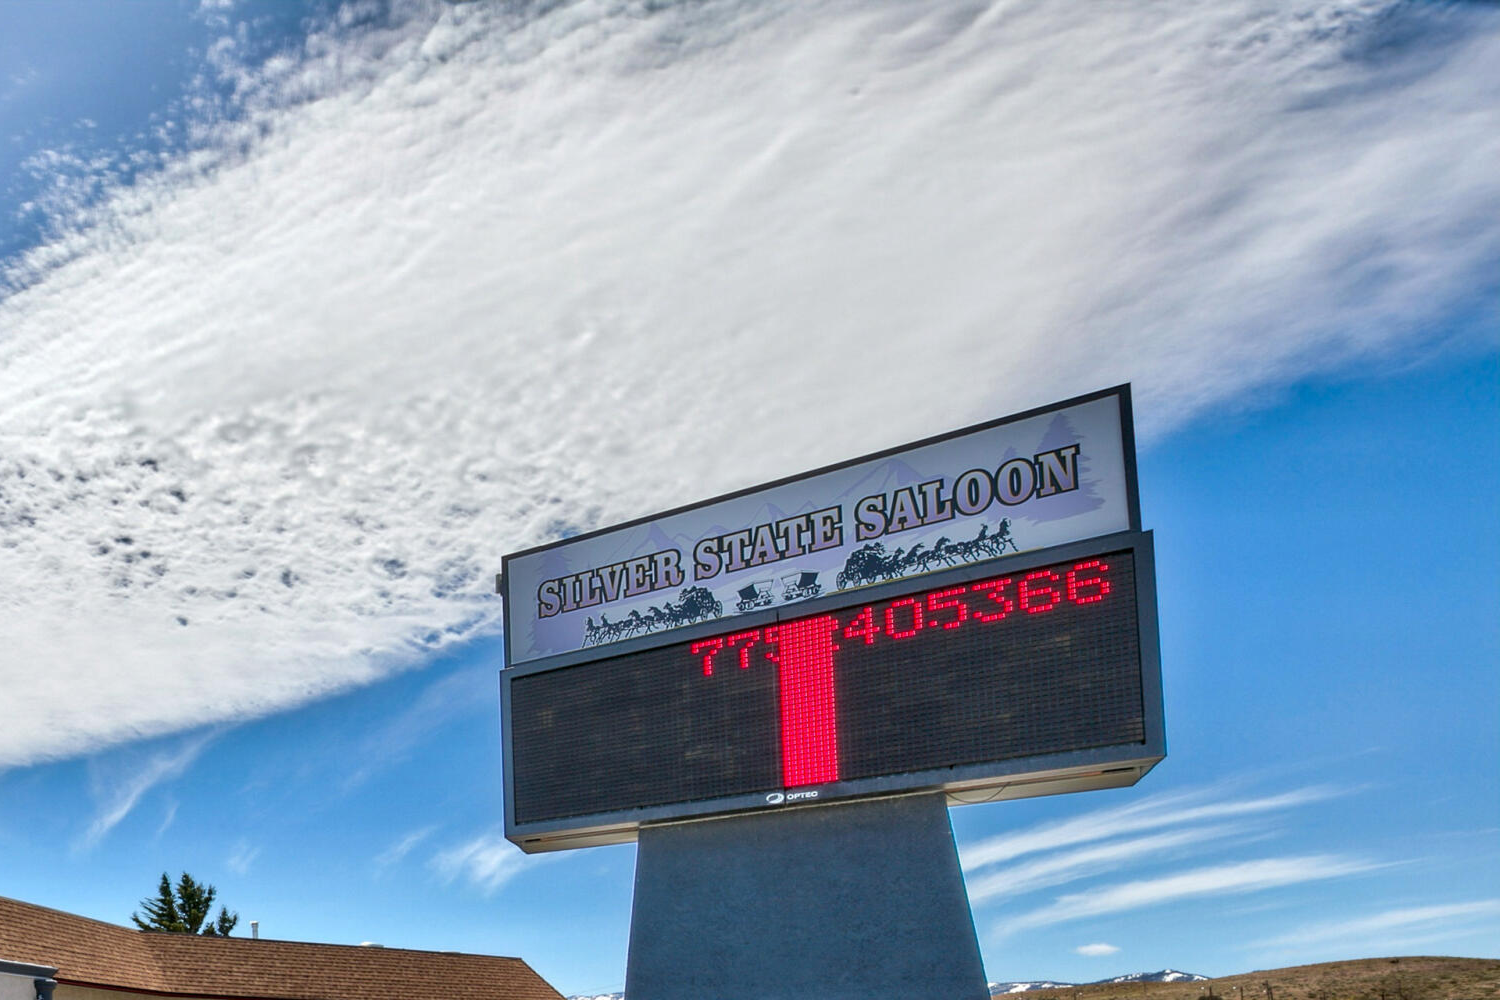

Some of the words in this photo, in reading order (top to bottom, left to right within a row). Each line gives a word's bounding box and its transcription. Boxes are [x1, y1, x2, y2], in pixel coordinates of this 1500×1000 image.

[538, 549, 686, 619] SILVER
[693, 505, 842, 581] STATE
[854, 443, 1080, 542] SALOON
[691, 560, 1110, 677] 77405366
